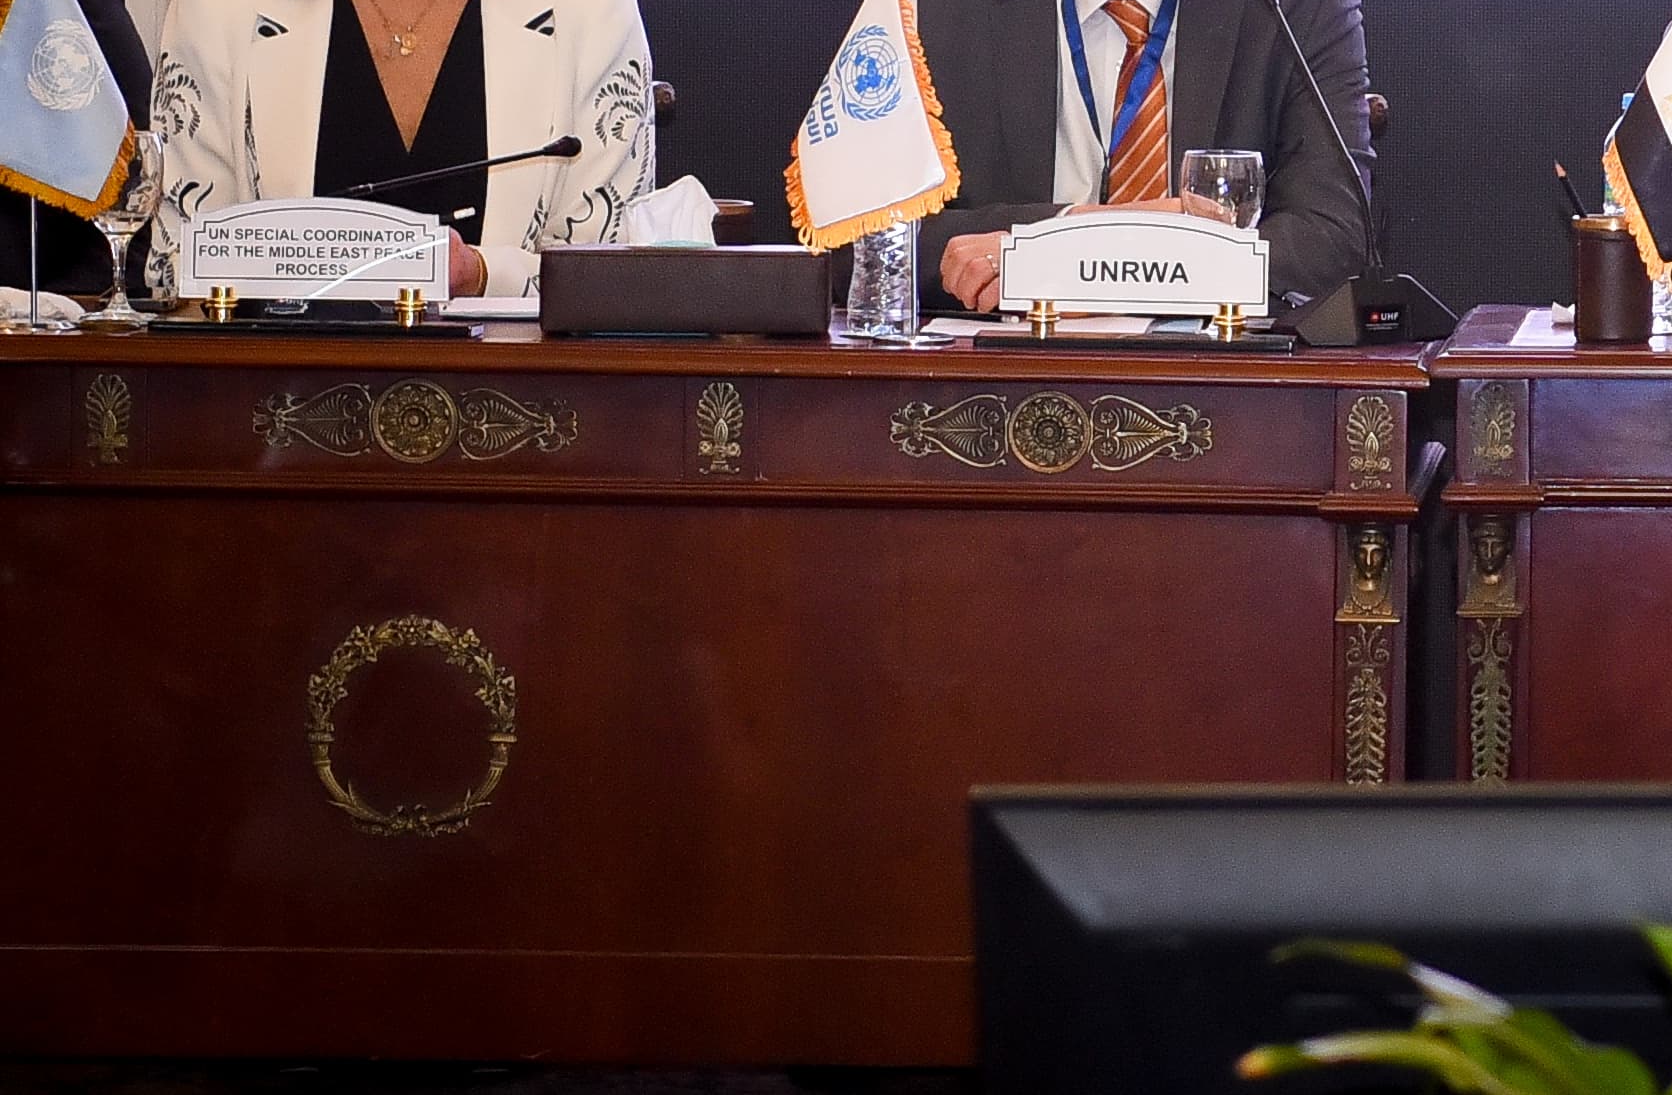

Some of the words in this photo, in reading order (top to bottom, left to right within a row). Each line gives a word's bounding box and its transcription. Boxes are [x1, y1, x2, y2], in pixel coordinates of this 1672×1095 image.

[208, 228, 229, 239] UN
[234, 228, 298, 241] SPECIAL
[303, 229, 416, 242] COORDINATOR
[199, 245, 230, 257] FOR
[235, 245, 264, 258] THE
[269, 247, 325, 259] MIDDLE
[331, 248, 369, 259] EAST
[275, 263, 348, 276] PROCESS
[1079, 260, 1189, 284] UNRWA
